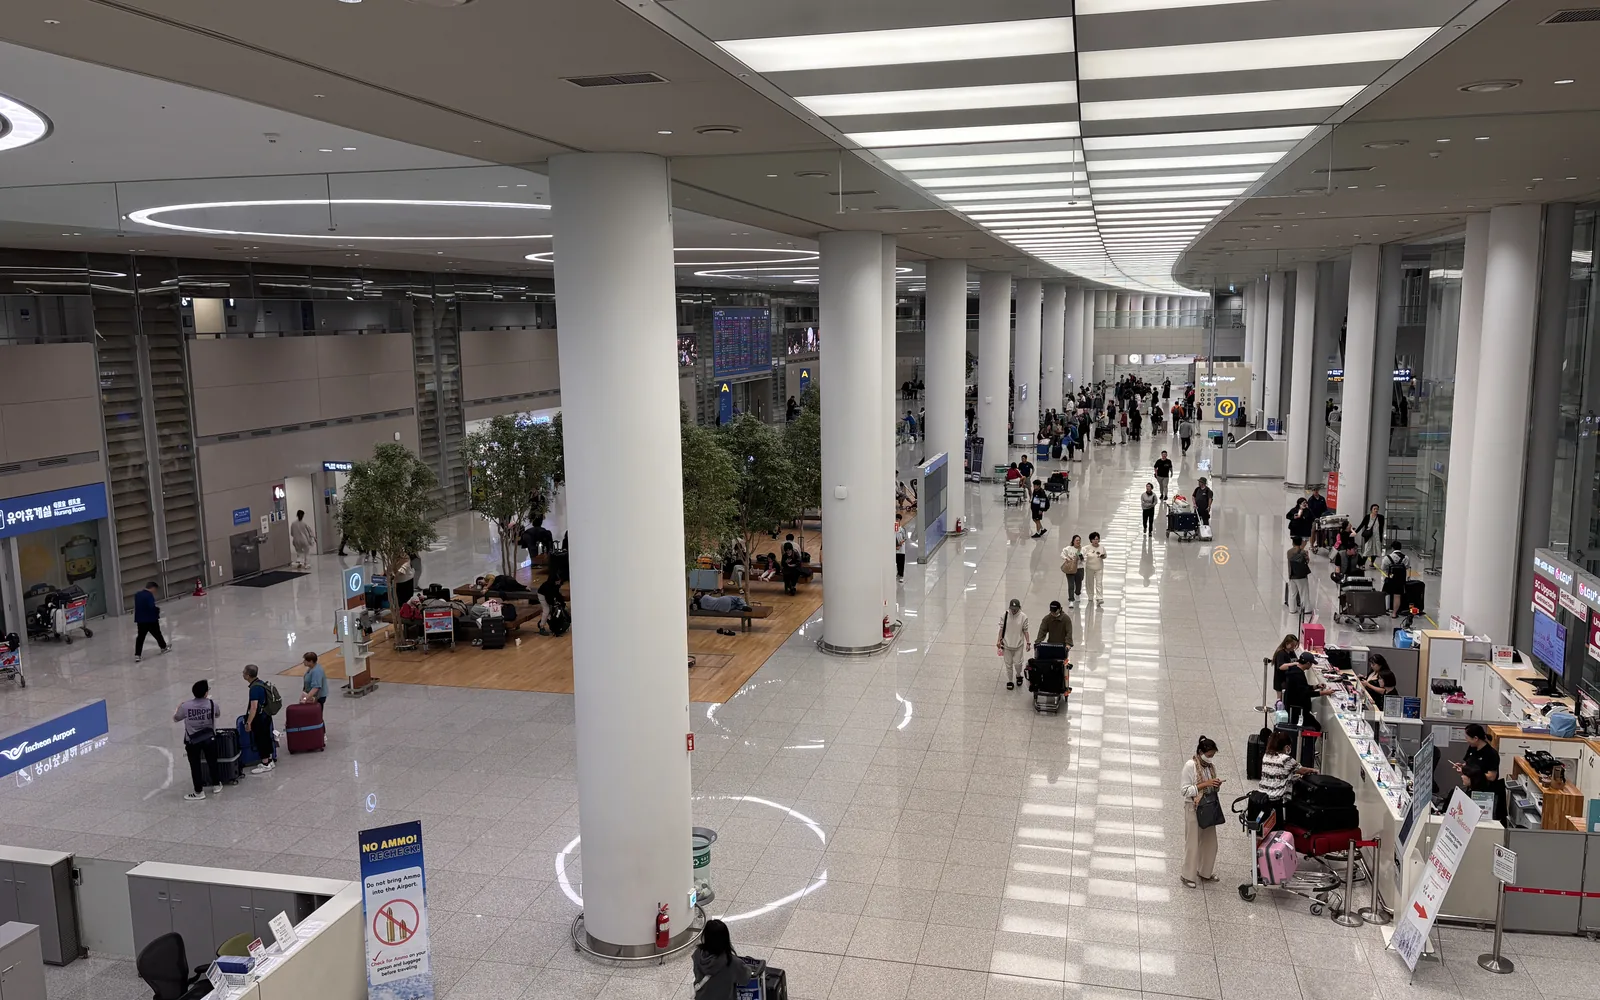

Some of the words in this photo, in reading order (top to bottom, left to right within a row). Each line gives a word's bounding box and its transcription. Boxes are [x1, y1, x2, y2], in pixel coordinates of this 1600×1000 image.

[721, 383, 729, 392] A
[7, 505, 52, 525] 유아휴게실
[25, 738, 52, 753] Incheon
[52, 727, 76, 742] Airport
[1449, 807, 1458, 819] SK
[1457, 816, 1471, 835] telecom
[362, 842, 378, 853] NO
[381, 835, 417, 849] AMMO!
[369, 844, 420, 862] RECHECK!
[397, 882, 417, 890] Airport.
[403, 873, 421, 881] Ammo
